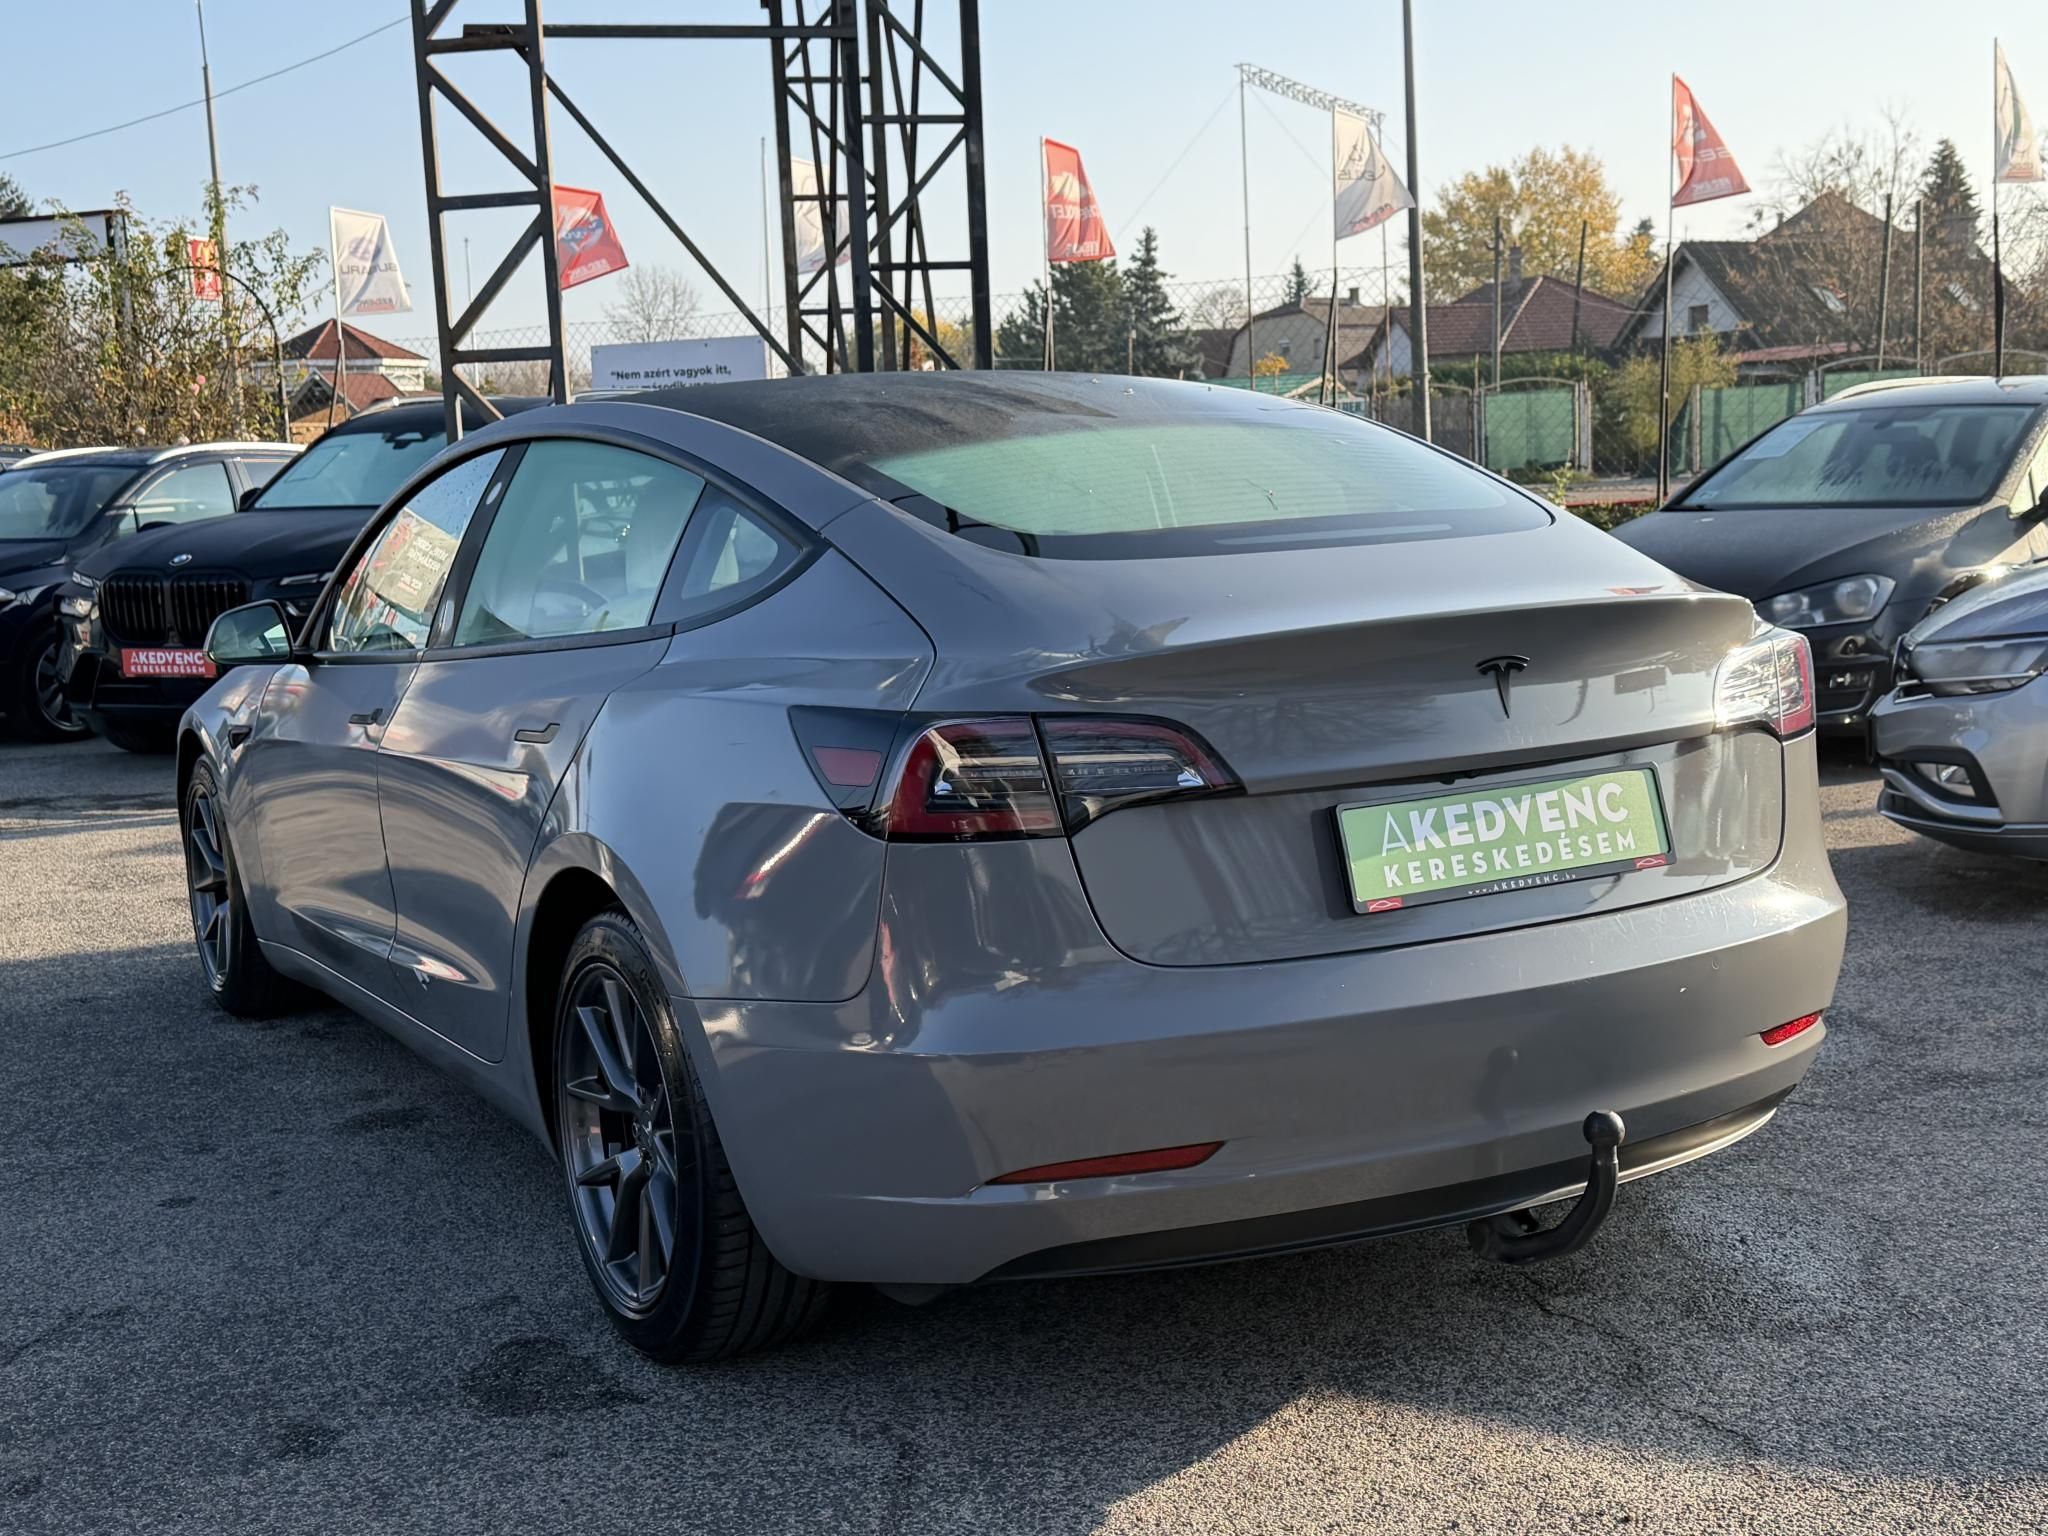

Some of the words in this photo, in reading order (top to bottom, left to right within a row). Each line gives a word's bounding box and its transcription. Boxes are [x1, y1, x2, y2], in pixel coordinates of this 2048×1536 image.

[644, 368, 670, 378] azért
[673, 365, 712, 379] vagyok
[715, 363, 731, 375] itt,
[1381, 782, 1629, 857] AKEDVENC
[1383, 827, 1636, 888] KERESKEDÉSEM
[1468, 873, 1576, 895] www.AKEDVENC.hu
